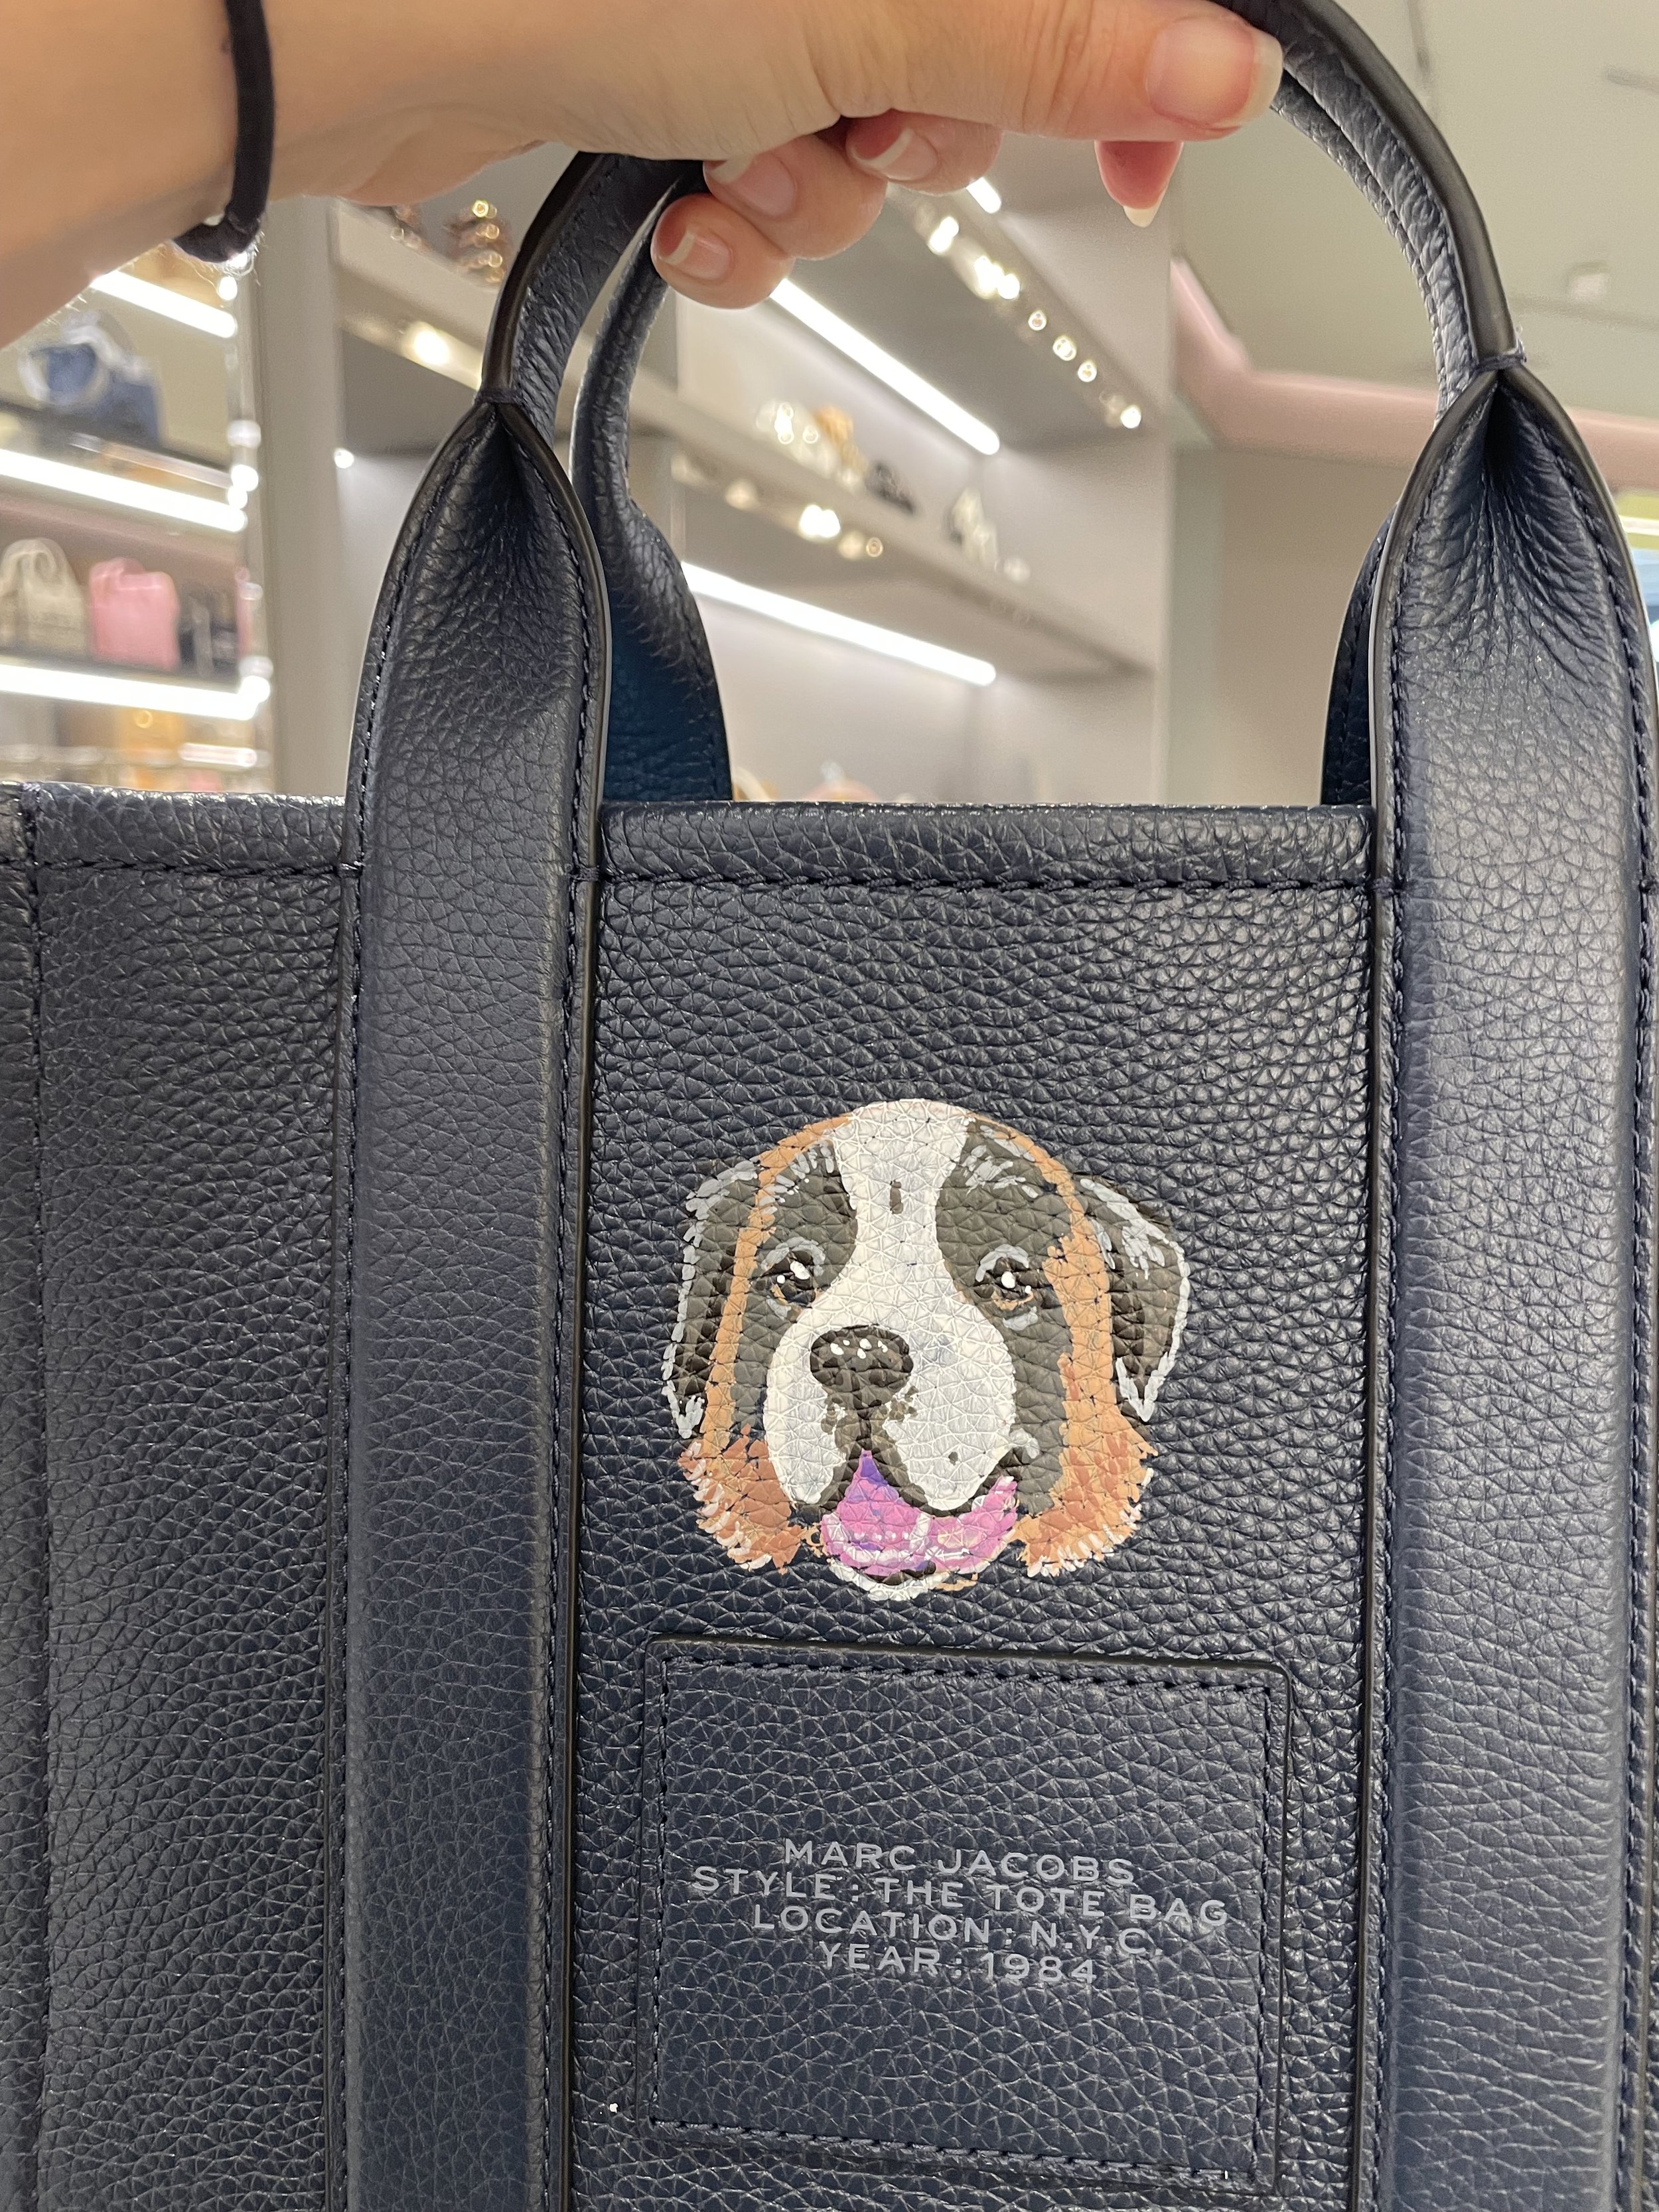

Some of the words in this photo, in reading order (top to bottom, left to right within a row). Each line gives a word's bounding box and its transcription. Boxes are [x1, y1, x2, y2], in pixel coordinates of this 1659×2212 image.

[785, 1838, 915, 1870] MARC
[938, 1850, 1134, 1885] JACOBS
[877, 1877, 964, 1908] THE
[987, 1885, 1106, 1918] TOTE
[1129, 1894, 1228, 1926] BAG
[1031, 1923, 1163, 1955] N.Y.C.
[981, 1953, 1096, 1984] 1984
